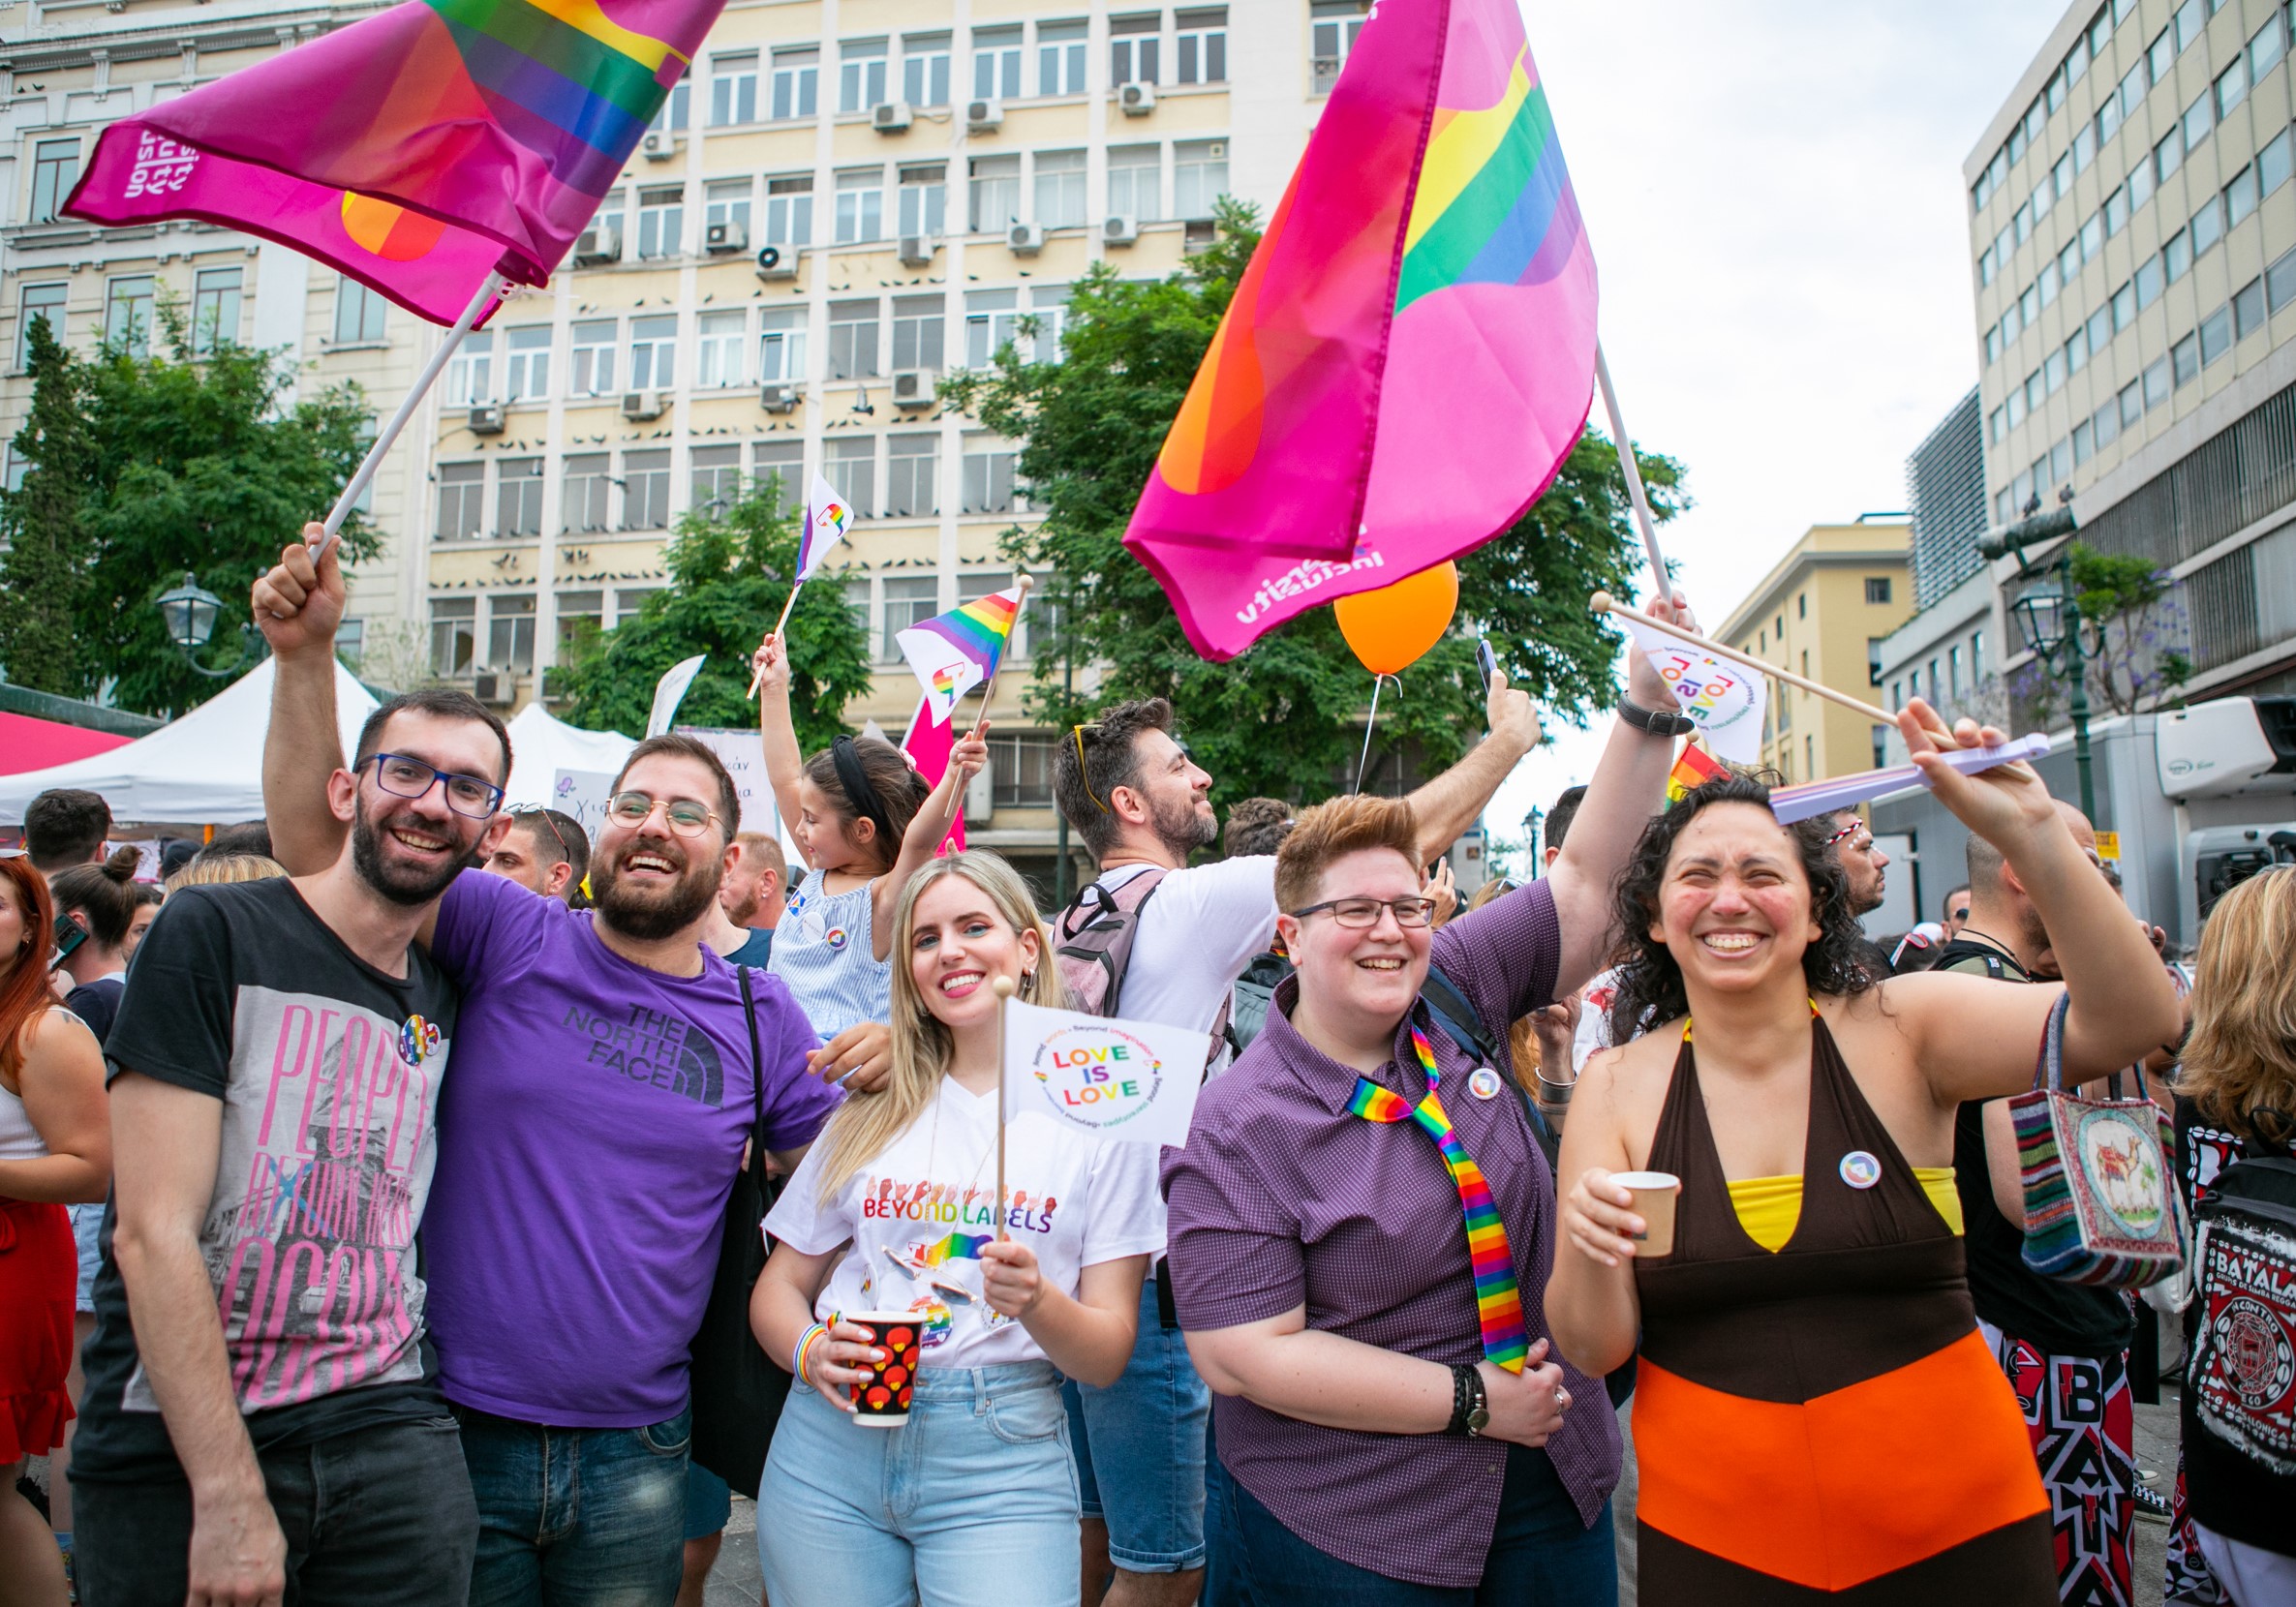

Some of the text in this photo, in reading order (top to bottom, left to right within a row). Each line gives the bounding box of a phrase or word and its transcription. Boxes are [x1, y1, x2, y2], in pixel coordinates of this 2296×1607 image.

[562, 1005, 679, 1070] NORTH
[628, 1001, 687, 1045] THE
[587, 1040, 674, 1091] FACE
[1053, 1046, 1130, 1069] LOVE
[1083, 1065, 1110, 1084] IS
[257, 1004, 430, 1175] PEOPLE
[1063, 1079, 1140, 1106] LOVE
[238, 1151, 361, 1243] RETURN
[863, 1198, 1054, 1234] BEYOND LABELS
